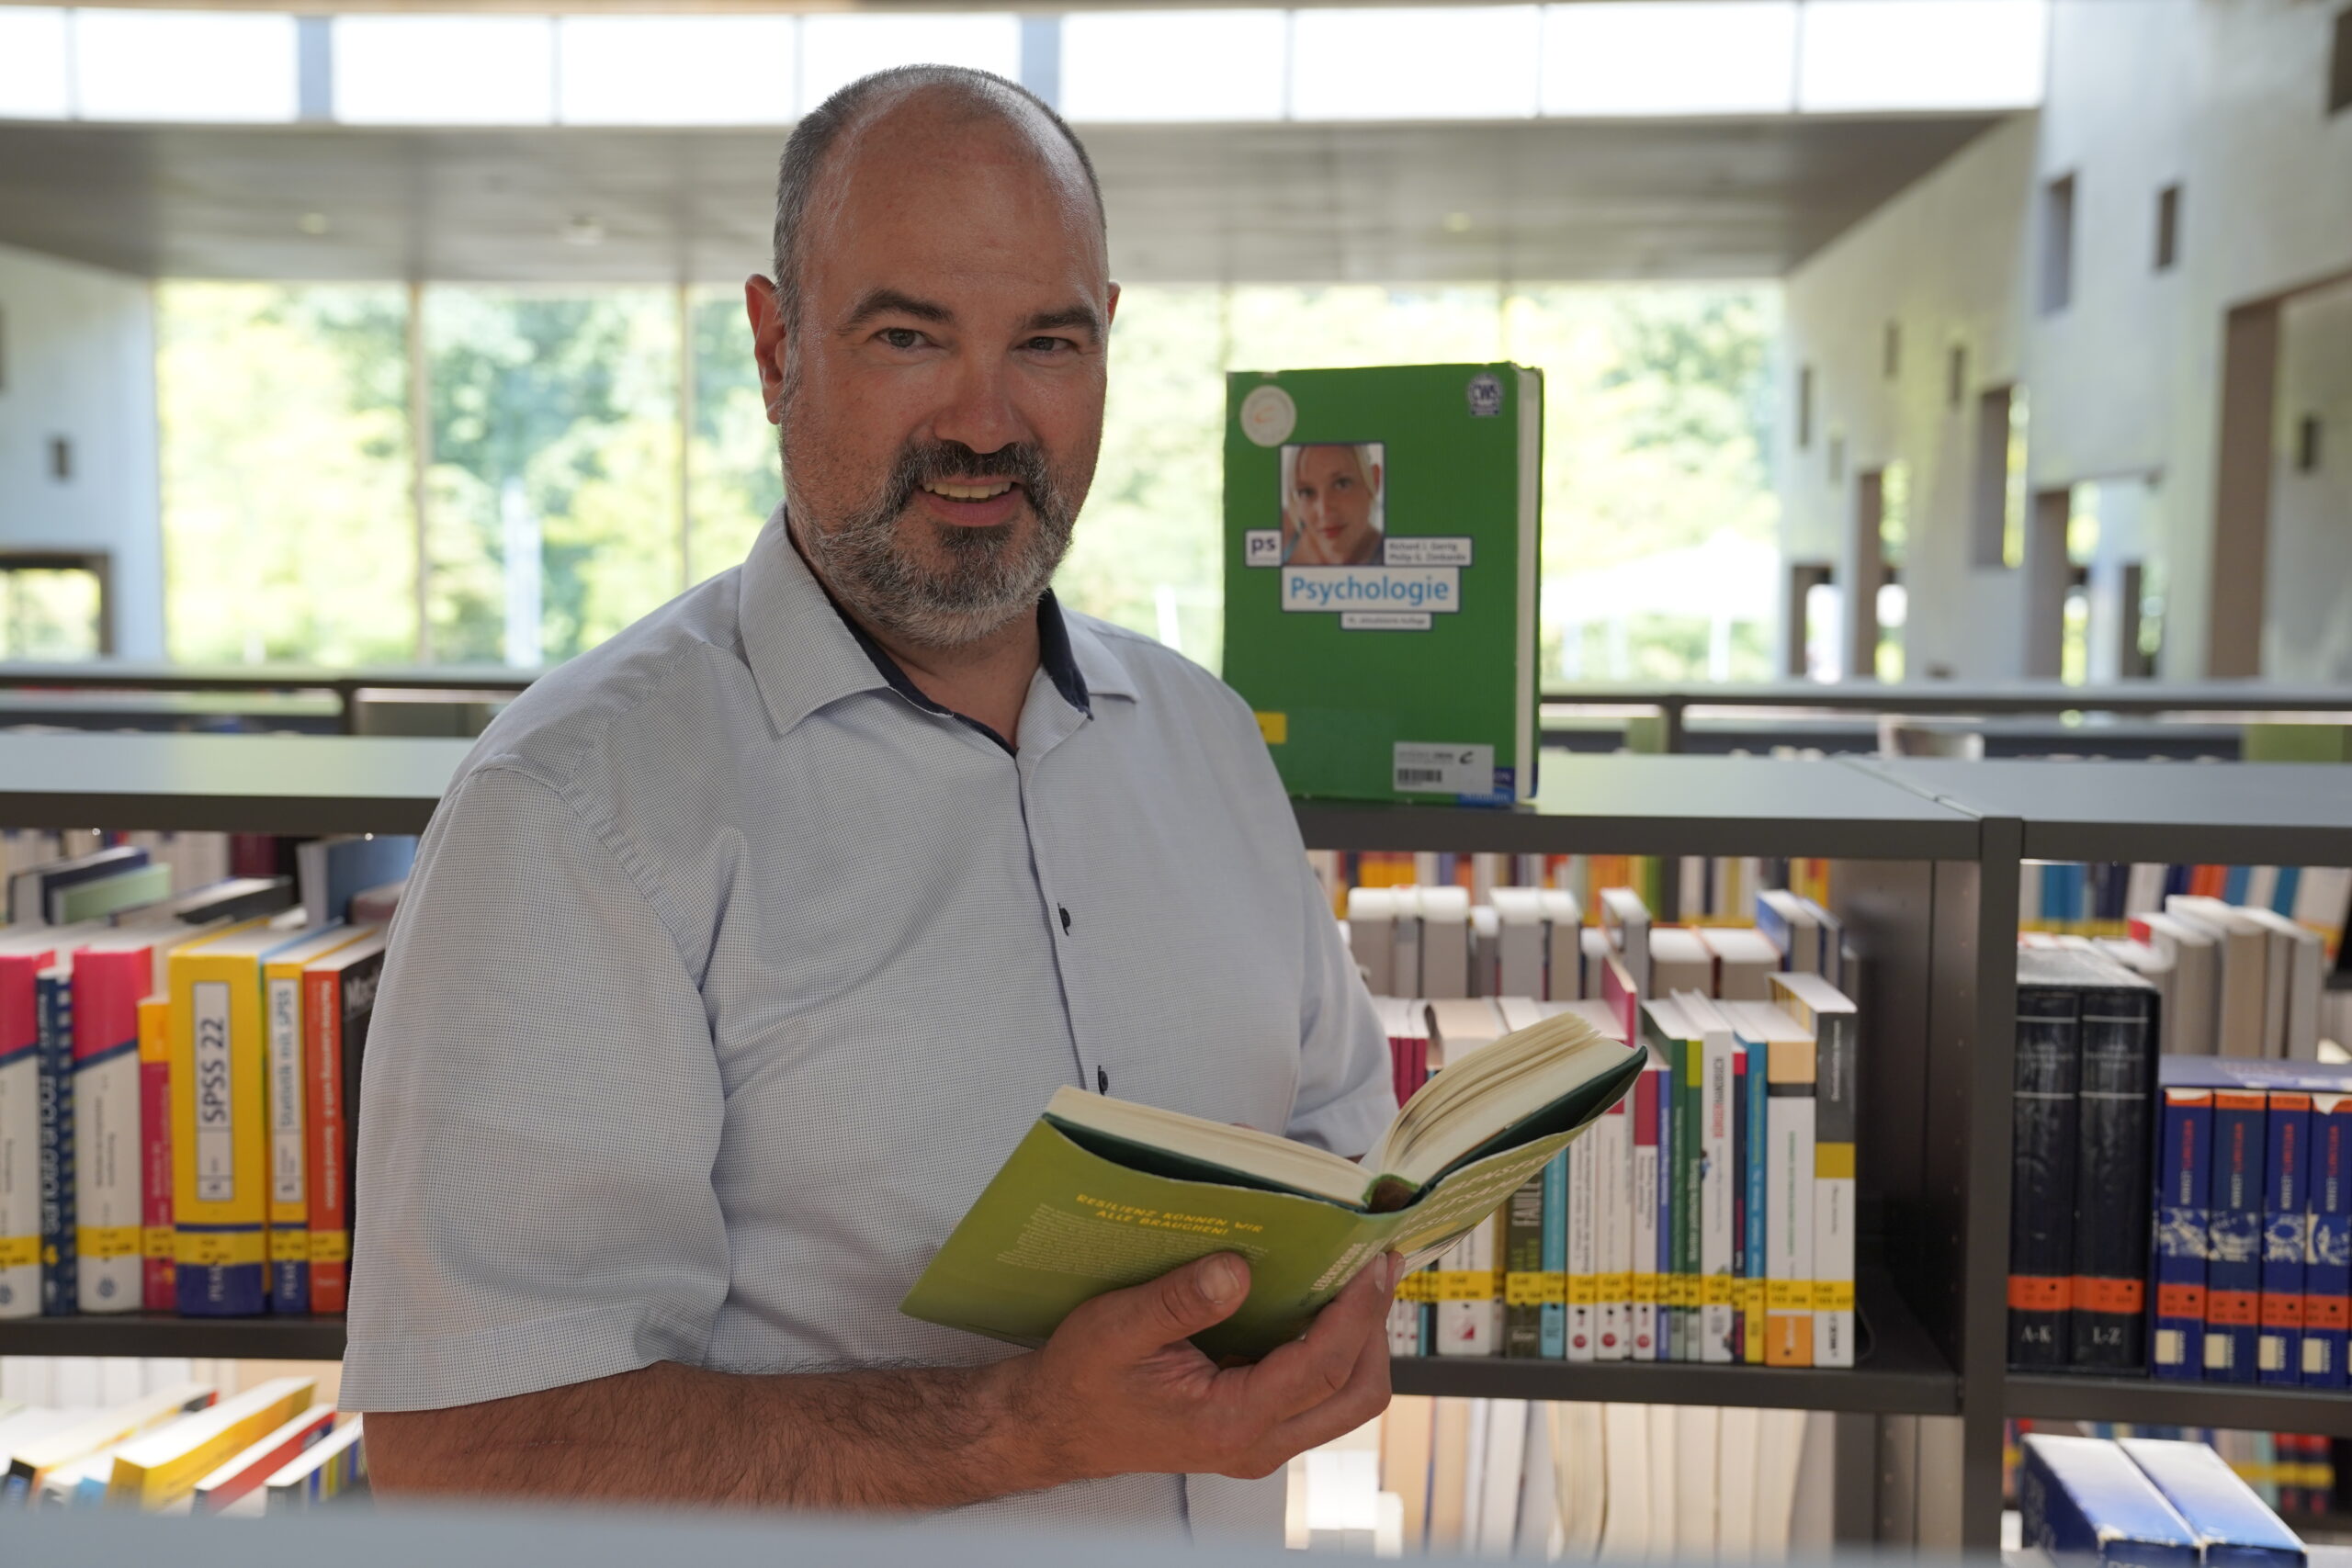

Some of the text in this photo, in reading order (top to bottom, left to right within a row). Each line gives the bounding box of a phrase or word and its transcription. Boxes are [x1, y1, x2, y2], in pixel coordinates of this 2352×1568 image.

[1251, 537, 1276, 555] ps
[1291, 574, 1450, 605] Psychologie
[276, 988, 291, 1026] SPSS
[201, 1018, 226, 1123] SPSS 22
[277, 1066, 293, 1127] Statistik
[1076, 1194, 1158, 1218] RESILIENZ
[1234, 1221, 1264, 1234] WIR
[1095, 1210, 1229, 1236] ALLE BRAUCHEN!
[2021, 1325, 2052, 1343] A-K
[2093, 1325, 2122, 1345] L-Z
